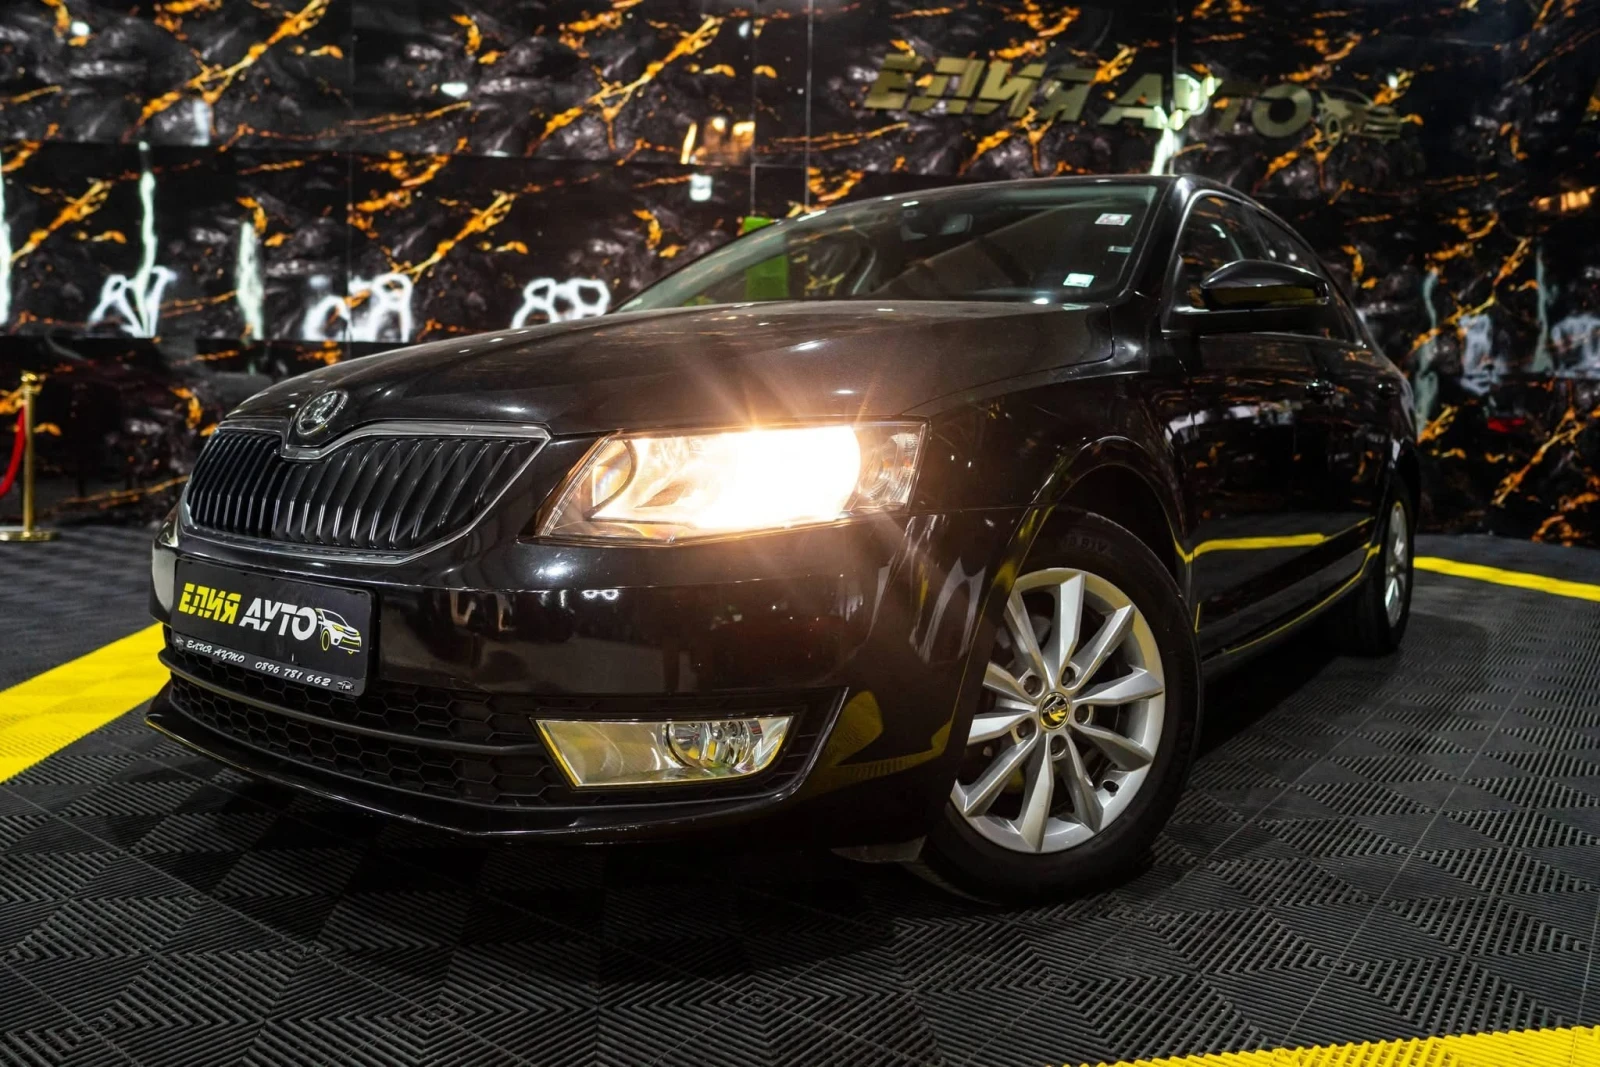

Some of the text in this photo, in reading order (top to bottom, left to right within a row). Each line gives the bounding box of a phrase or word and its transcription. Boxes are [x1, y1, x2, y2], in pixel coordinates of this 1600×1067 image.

[178, 582, 318, 641] ЕЛИЯ АУТО
[255, 662, 280, 674] 0896
[284, 668, 303, 680] 781
[306, 674, 332, 687] 662
